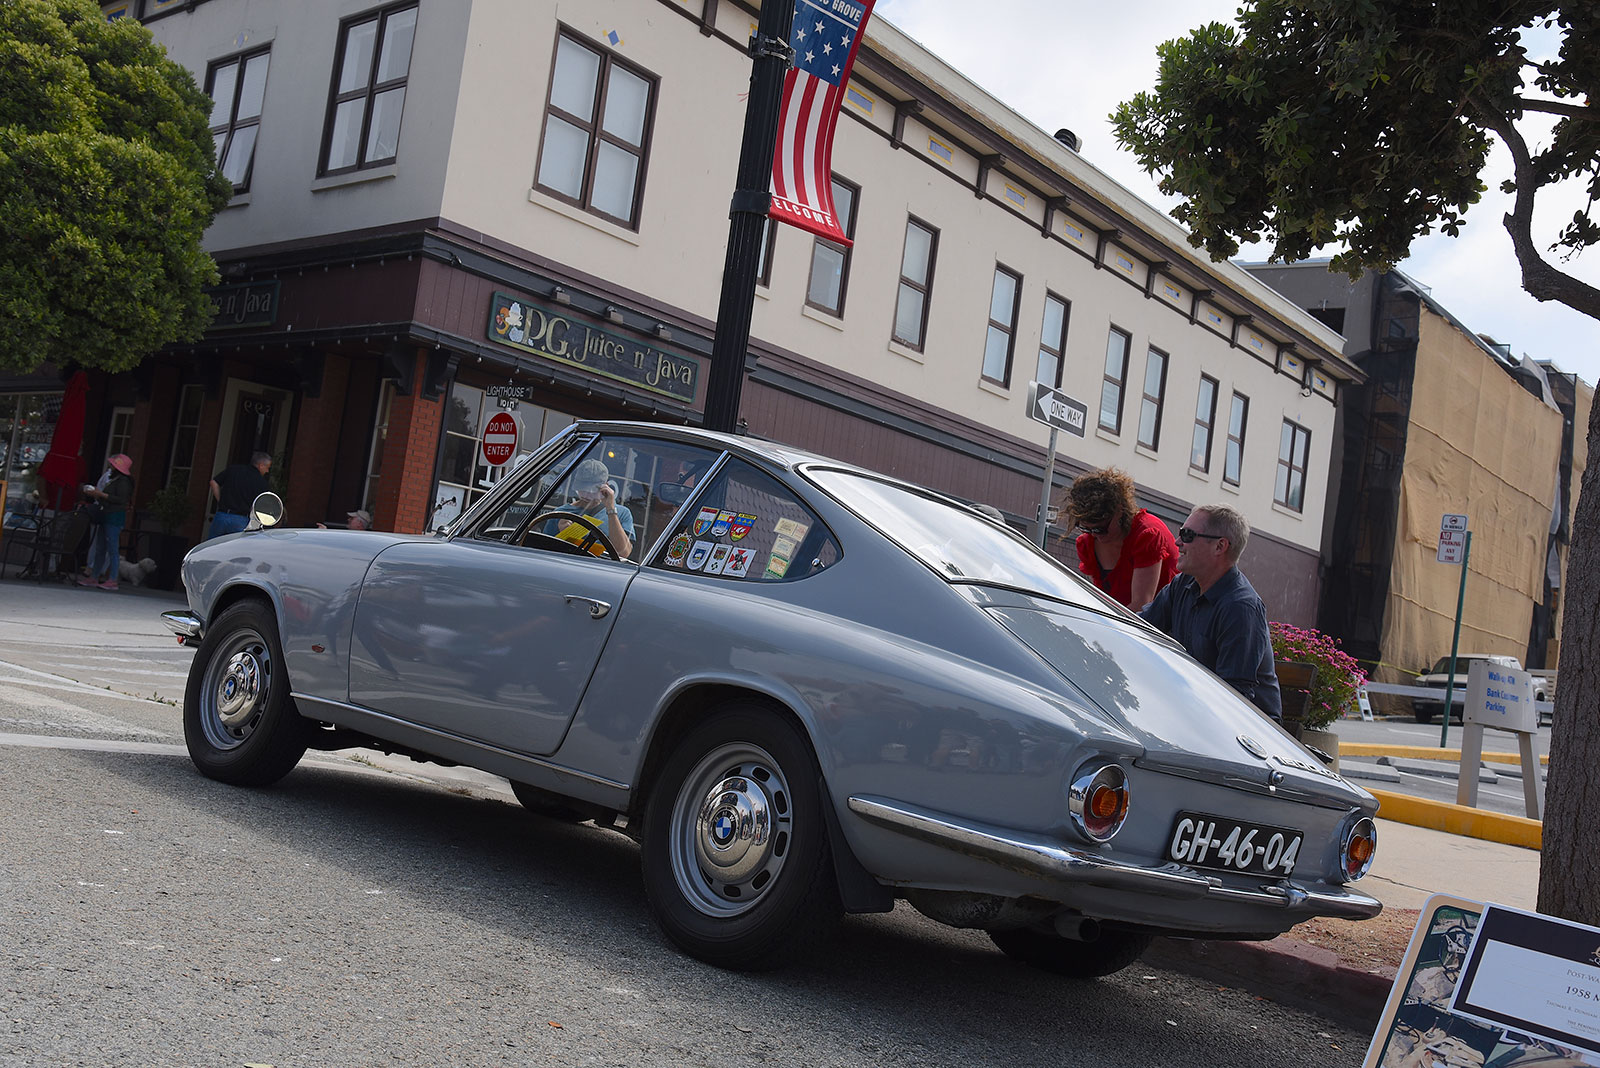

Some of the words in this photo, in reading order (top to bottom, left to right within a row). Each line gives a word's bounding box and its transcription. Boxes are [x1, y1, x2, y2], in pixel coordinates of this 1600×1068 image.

[832, 0, 862, 22] GROVE
[773, 198, 834, 228] ELCOME
[234, 288, 271, 323] Java
[522, 306, 570, 359] P.G.
[573, 327, 625, 363] Juice
[646, 352, 693, 387] Java
[486, 385, 525, 397] LIGHTHOUSE
[1050, 401, 1065, 418] ONE
[1066, 409, 1082, 425] WAY
[489, 422, 499, 431] DO
[500, 422, 513, 432] NOT
[487, 445, 510, 456] ENTER
[1441, 532, 1450, 540] NO
[1486, 687, 1500, 698] Bank
[1485, 700, 1506, 715] Parking
[1170, 818, 1301, 874] GH-46-04
[1566, 986, 1591, 999] 1958
